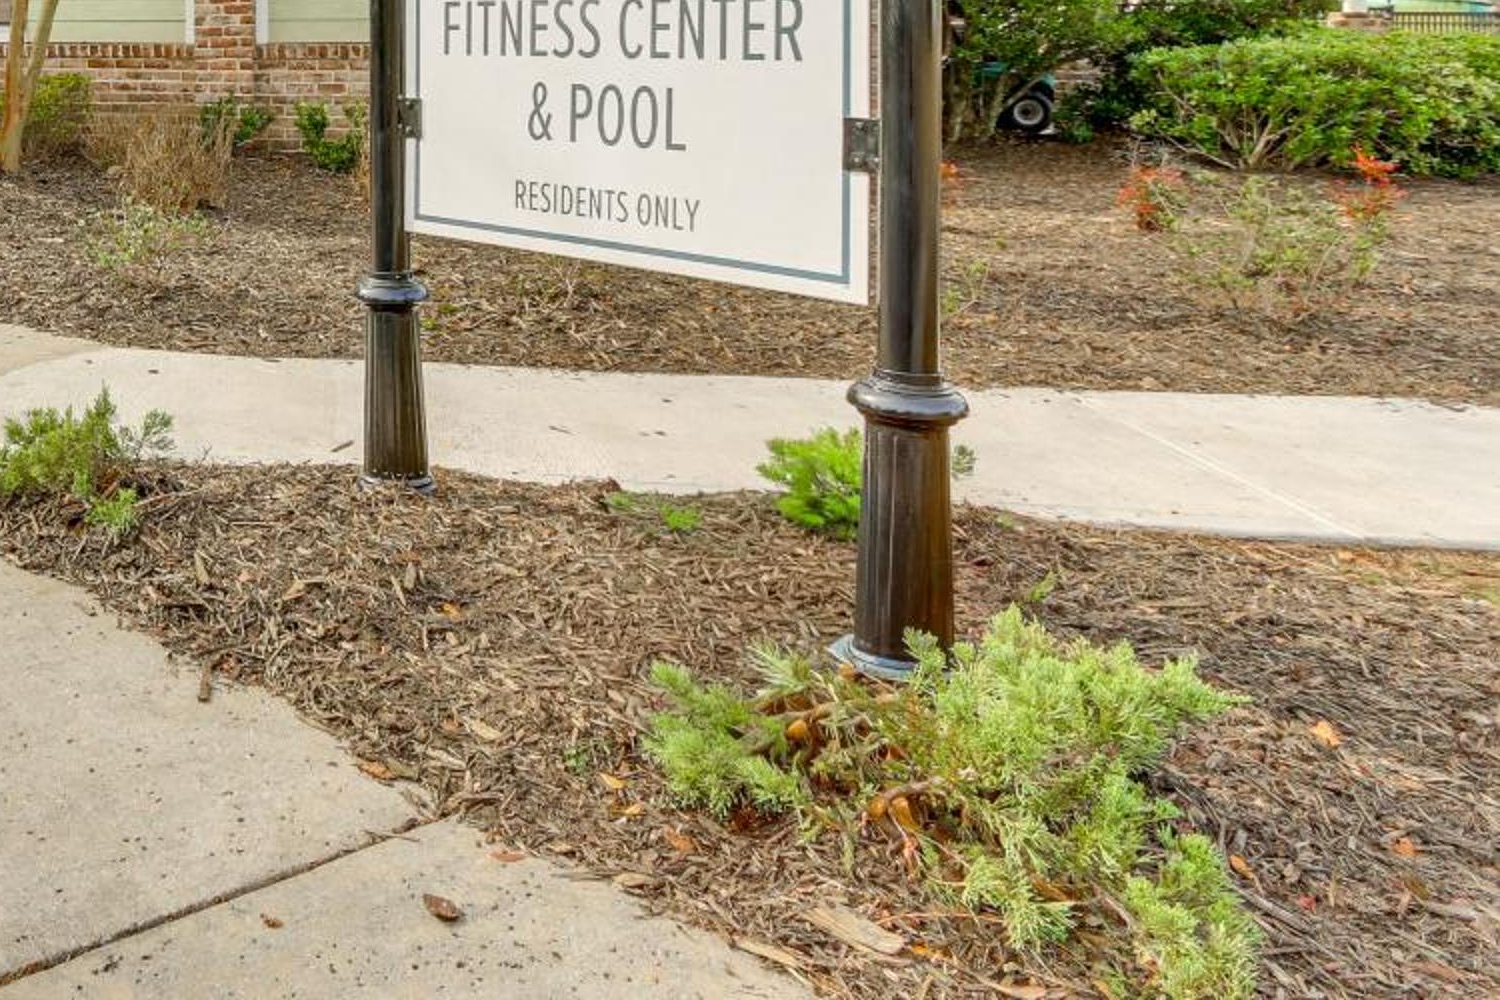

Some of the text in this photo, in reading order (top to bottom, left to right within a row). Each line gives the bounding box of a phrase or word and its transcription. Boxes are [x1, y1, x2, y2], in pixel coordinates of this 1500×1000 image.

[528, 82, 686, 151] & POOL
[516, 180, 699, 231] RESIDENTS ONLY
